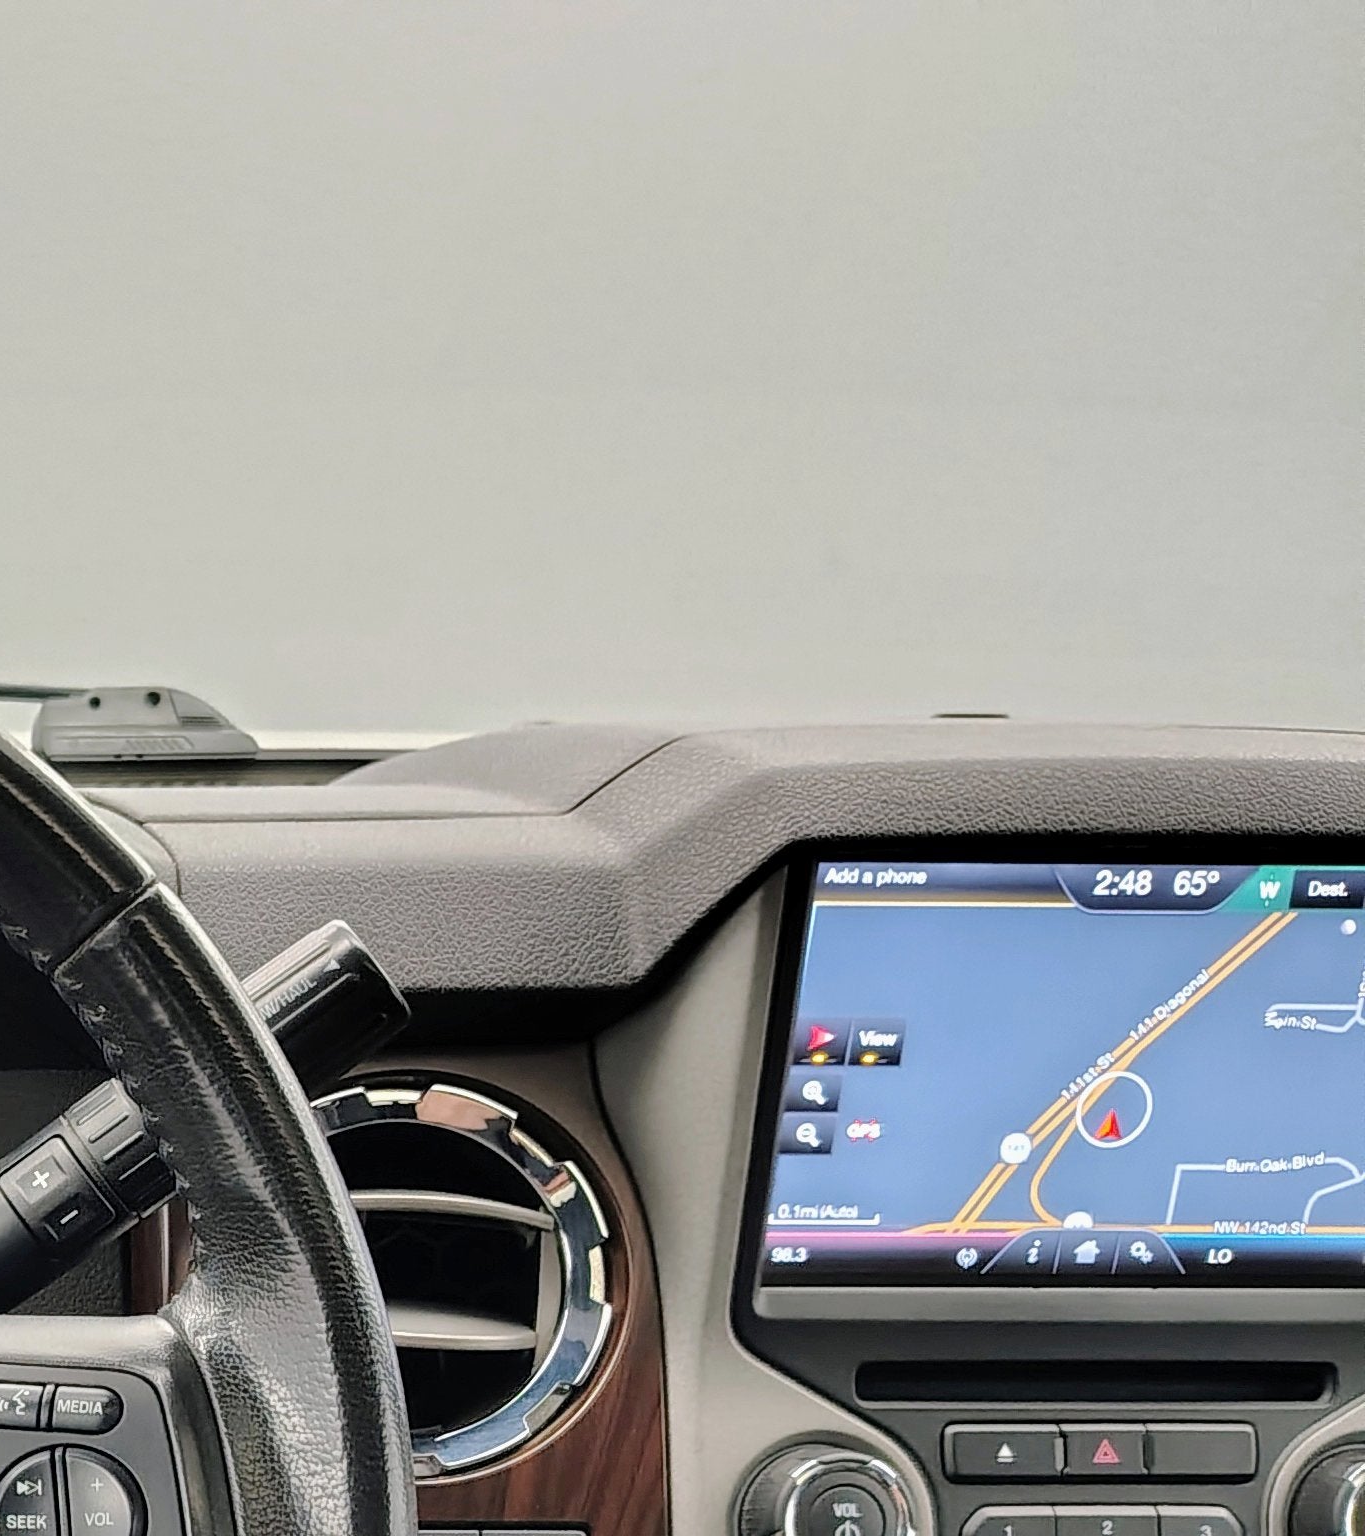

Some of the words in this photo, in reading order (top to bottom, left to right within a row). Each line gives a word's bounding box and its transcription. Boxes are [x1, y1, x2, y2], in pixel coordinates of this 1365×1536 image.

[824, 867, 859, 884] Add
[862, 871, 873, 884] a
[875, 867, 928, 888] phone
[1092, 869, 1153, 897] 2:48
[1258, 880, 1281, 899] W
[1307, 881, 1349, 898] Dest.
[259, 979, 318, 1020] W/HAUL
[1152, 968, 1211, 1021] Diagonal
[858, 1030, 898, 1048] View
[1225, 1157, 1256, 1173] Burr
[1259, 1157, 1289, 1173] Oak
[1291, 1151, 1326, 1171] Blvd
[1213, 1220, 1239, 1234] NW
[1244, 1220, 1288, 1235] 142nd
[1288, 1220, 1307, 1235] St
[1207, 1248, 1234, 1265] LO
[56, 1398, 104, 1416] MEDIA
[832, 1502, 865, 1518] VOL
[5, 1513, 48, 1531] SEEK
[84, 1512, 115, 1528] VOL
[1100, 1520, 1115, 1536] 2
